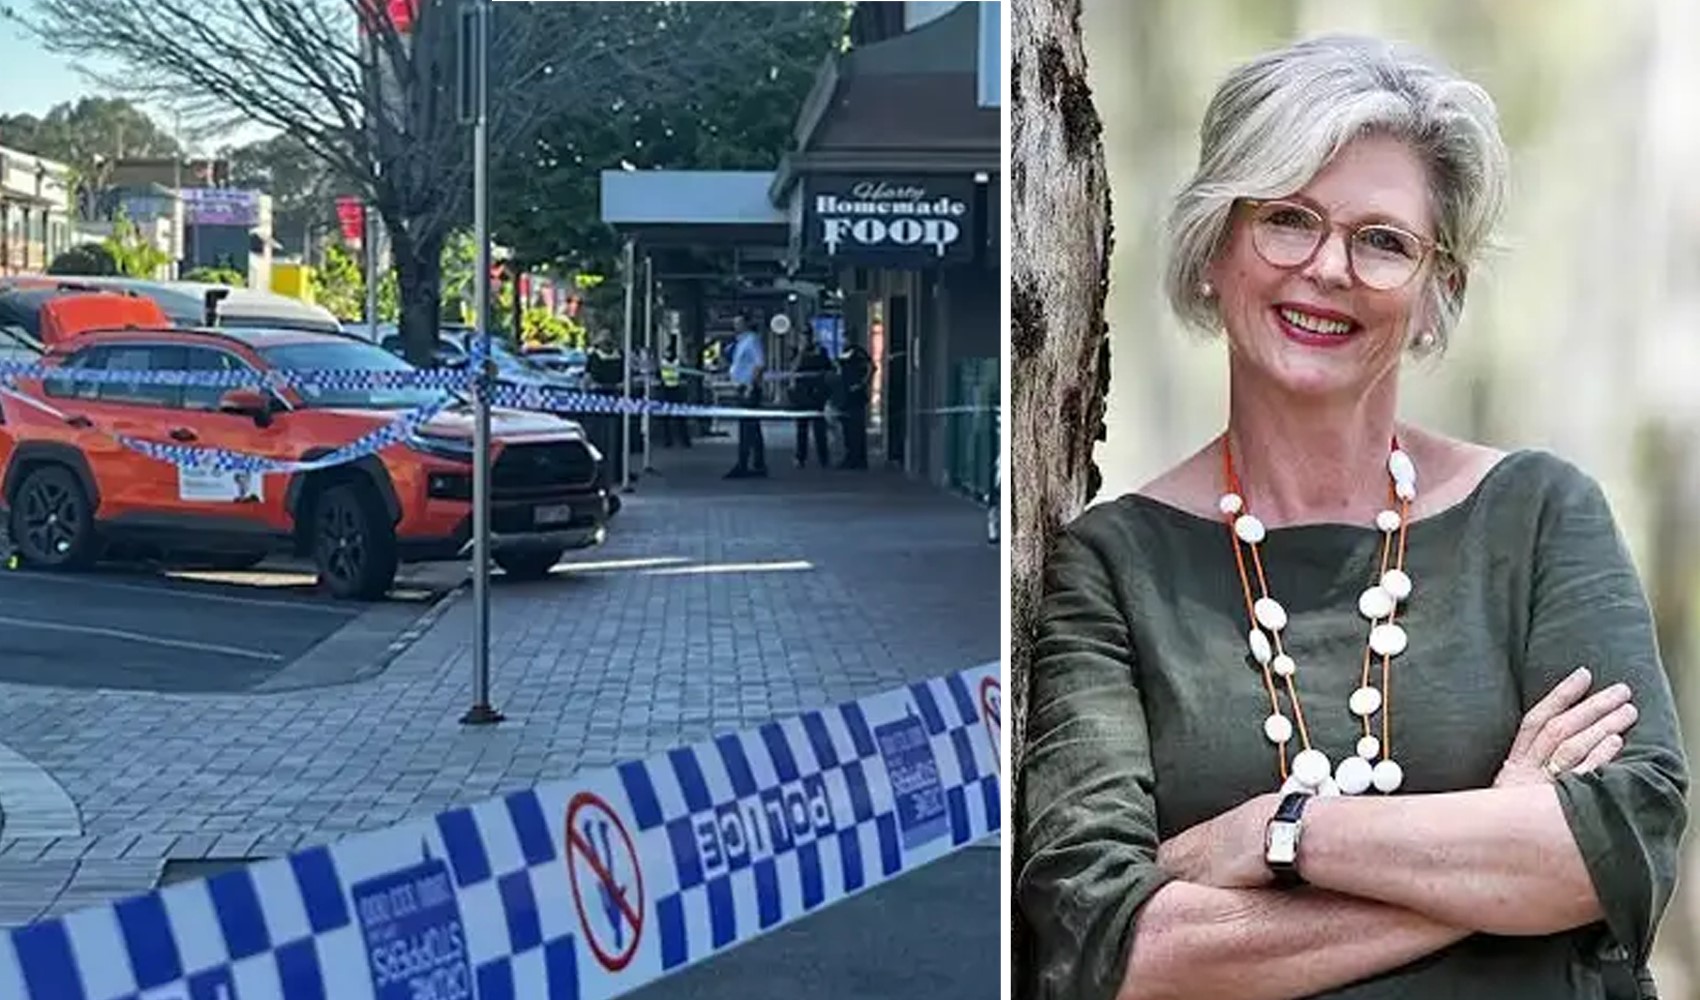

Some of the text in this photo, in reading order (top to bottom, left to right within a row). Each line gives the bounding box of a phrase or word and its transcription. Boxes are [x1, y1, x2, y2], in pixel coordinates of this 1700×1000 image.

[816, 196, 965, 215] Homemade
[824, 218, 959, 256] FOOD
[698, 784, 831, 869] POLICE
